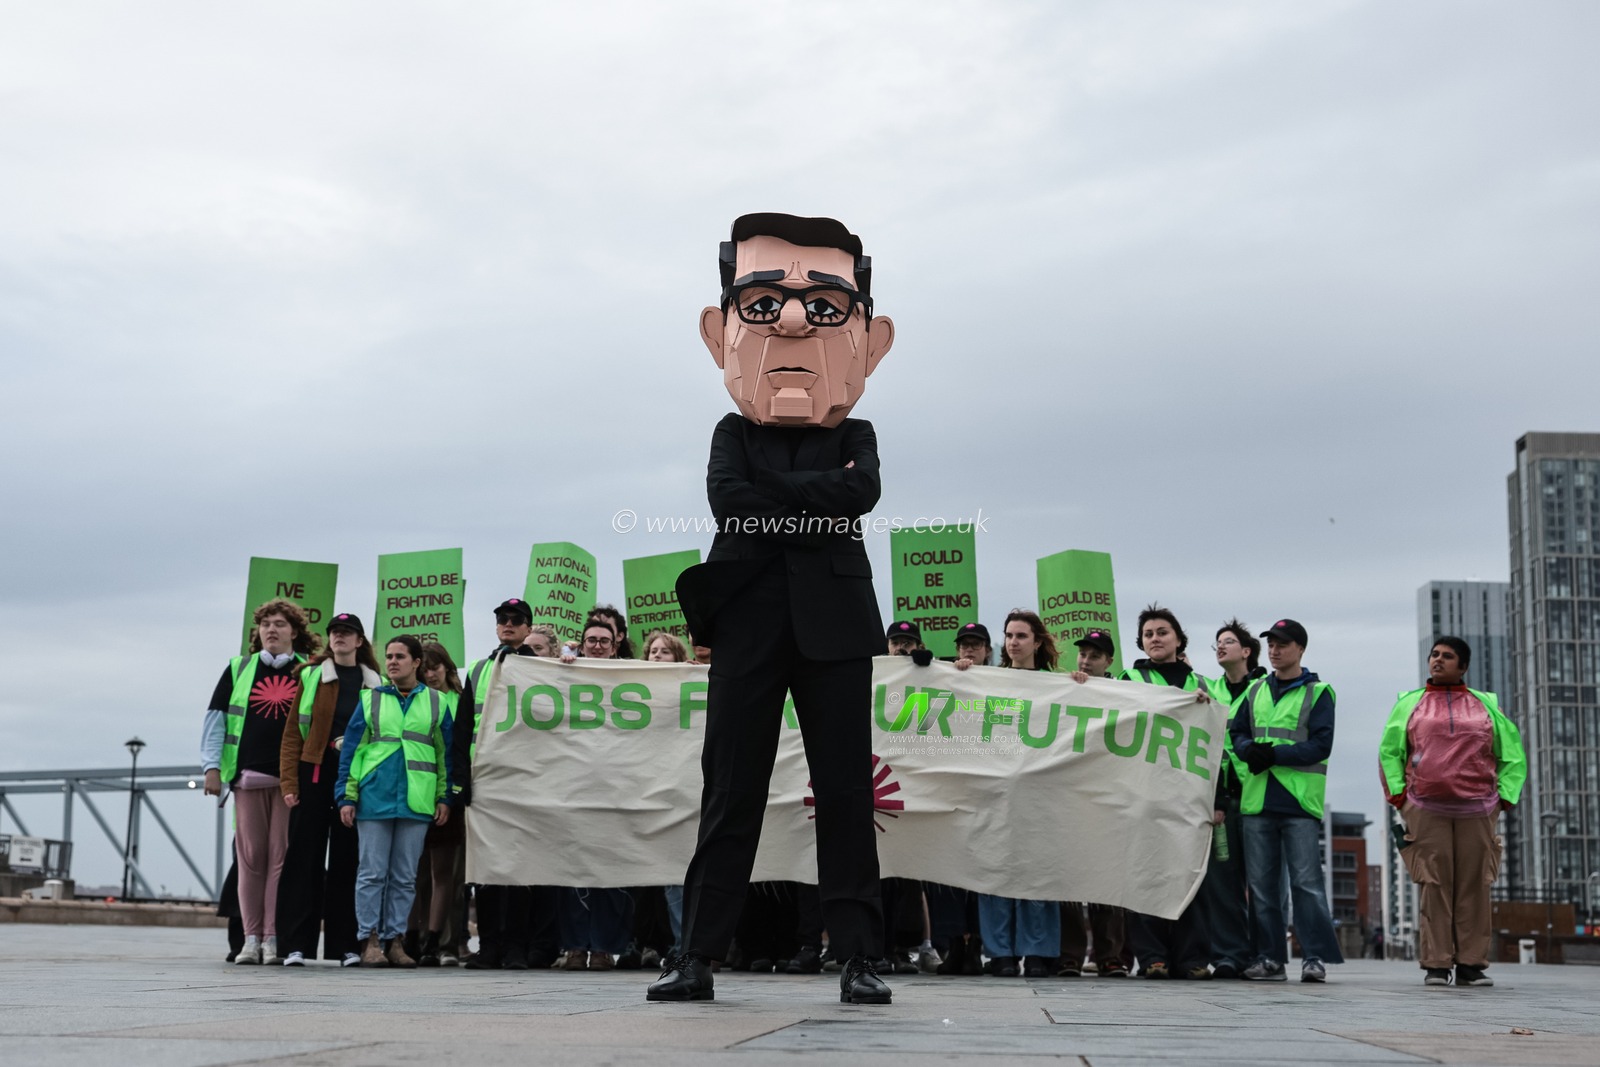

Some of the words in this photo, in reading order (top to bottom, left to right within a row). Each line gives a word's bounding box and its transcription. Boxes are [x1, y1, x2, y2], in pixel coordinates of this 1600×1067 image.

[535, 556, 592, 578] NATIONAL
[903, 552, 908, 567] I
[909, 549, 963, 566] COULD
[381, 579, 386, 591] I
[387, 574, 438, 590] COULD
[440, 572, 459, 586] BE
[537, 573, 589, 593] CLIMATE
[924, 572, 944, 588] BE
[275, 581, 305, 599] I'VE
[547, 589, 576, 604] AND
[386, 592, 454, 610] FIGHTING
[627, 597, 633, 610] I
[633, 590, 679, 608] COULD
[896, 593, 972, 611] PLANTING
[1041, 598, 1046, 612] I
[1047, 590, 1093, 610] COULD
[1094, 591, 1111, 606] BE
[390, 612, 451, 629] CLIMATE
[533, 605, 583, 624] NATURE
[629, 608, 683, 625] RETROFITT
[913, 615, 959, 631] TREES
[1043, 609, 1113, 627] PROTECTING
[533, 622, 583, 643] VICE
[495, 682, 652, 732] JOBS
[874, 683, 956, 739] UR
[982, 695, 1212, 780] FUTURE
